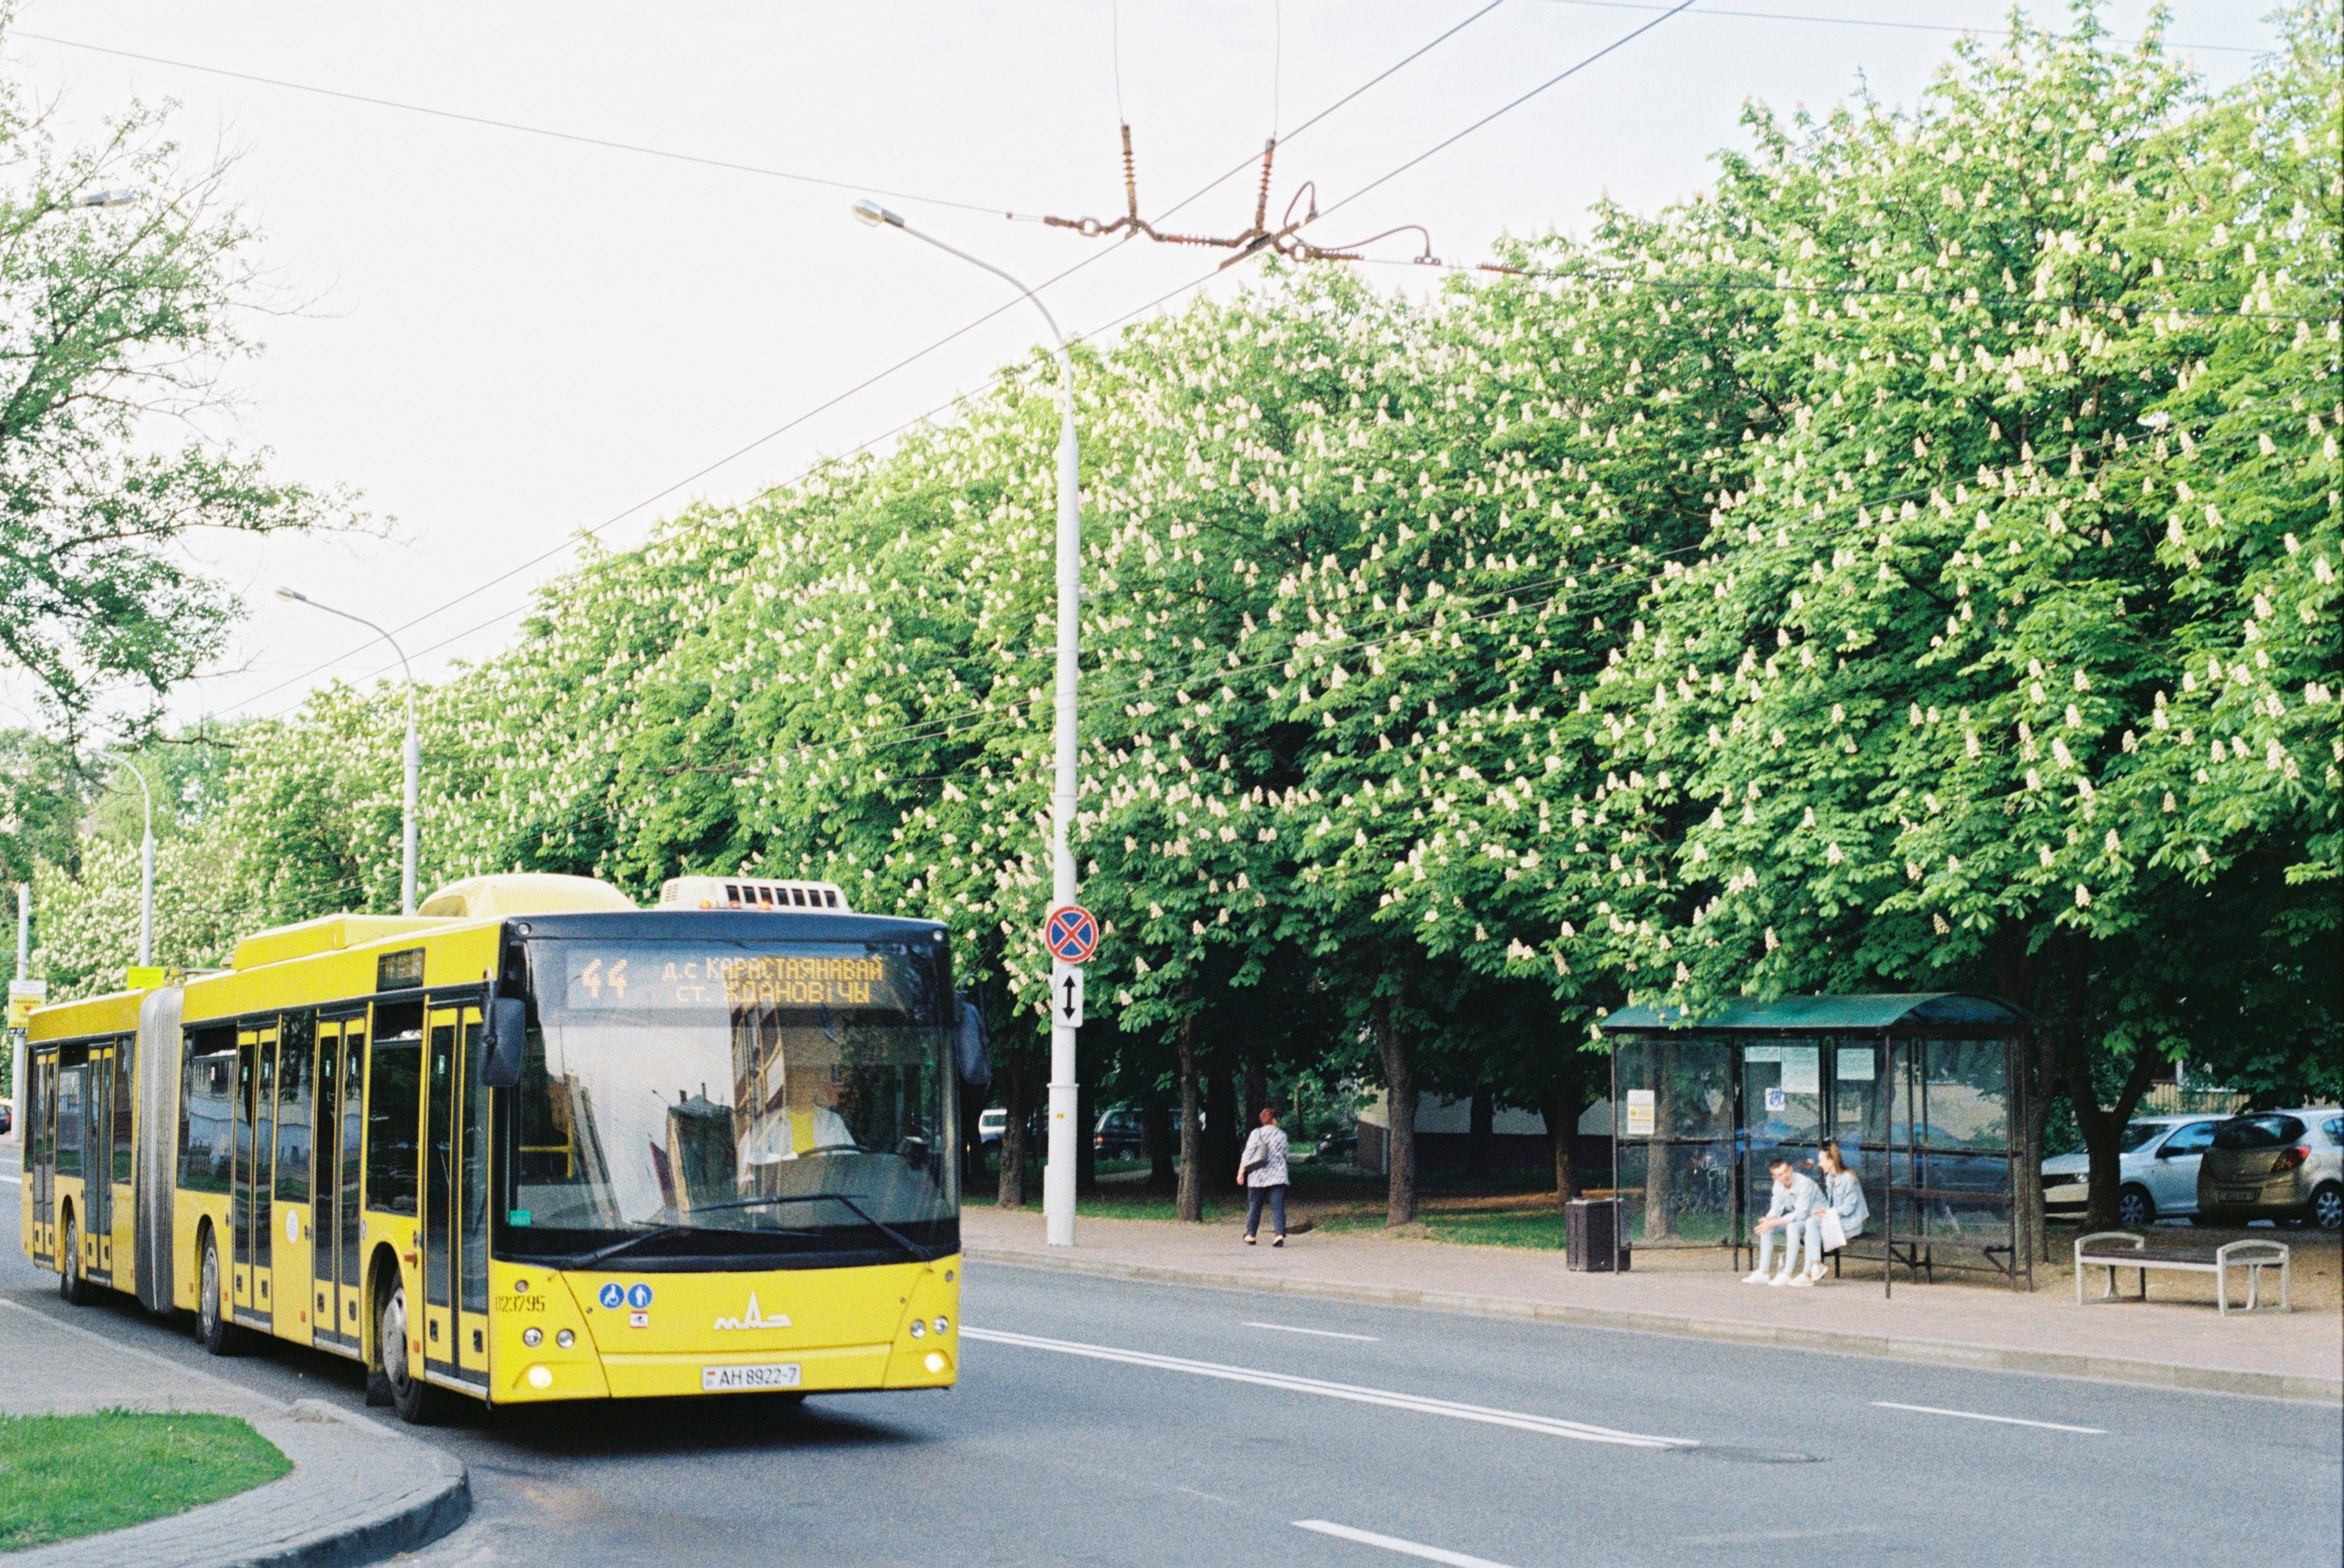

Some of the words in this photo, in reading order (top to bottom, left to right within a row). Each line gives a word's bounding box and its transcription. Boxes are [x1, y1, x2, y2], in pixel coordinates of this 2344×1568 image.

[582, 958, 628, 998] 44
[719, 1369, 742, 1386] AH
[746, 1367, 797, 1385] 8922-7
